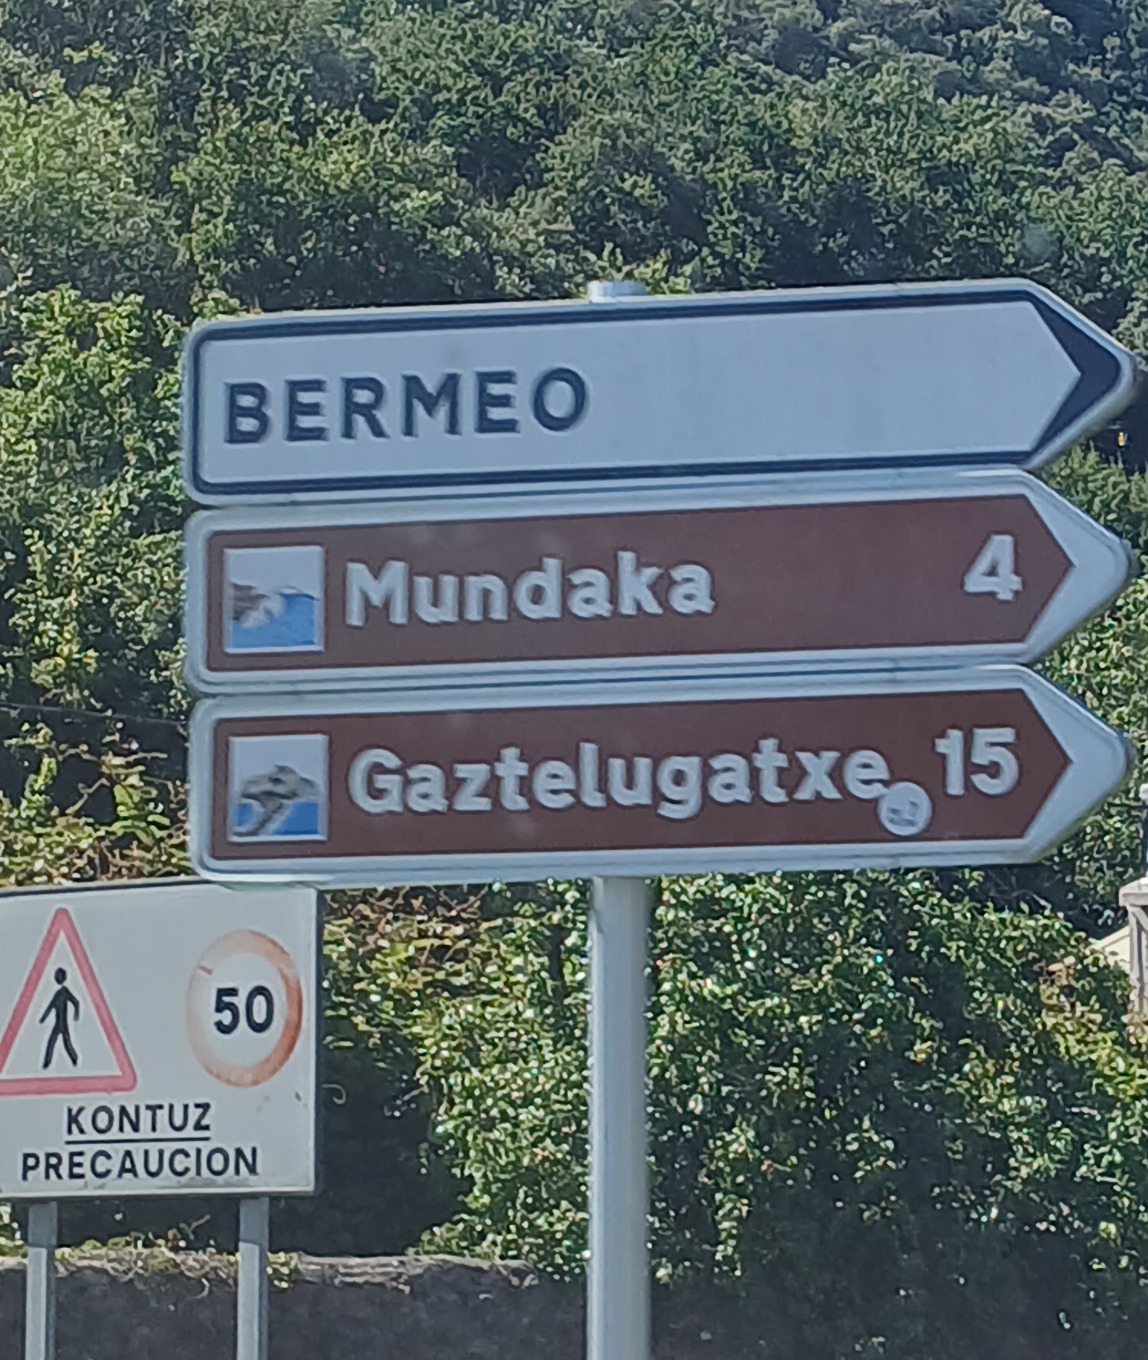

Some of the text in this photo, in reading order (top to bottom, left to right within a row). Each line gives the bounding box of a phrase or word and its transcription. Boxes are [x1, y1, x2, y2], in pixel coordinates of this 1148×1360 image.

[224, 367, 589, 444] BERMEO
[344, 534, 1023, 628] Mundaka 4
[347, 727, 1019, 820] Gaztelugatxe 15
[213, 985, 275, 1034] 50
[66, 1102, 212, 1135] KONTUZ
[22, 1146, 259, 1181] PRECAUCION
